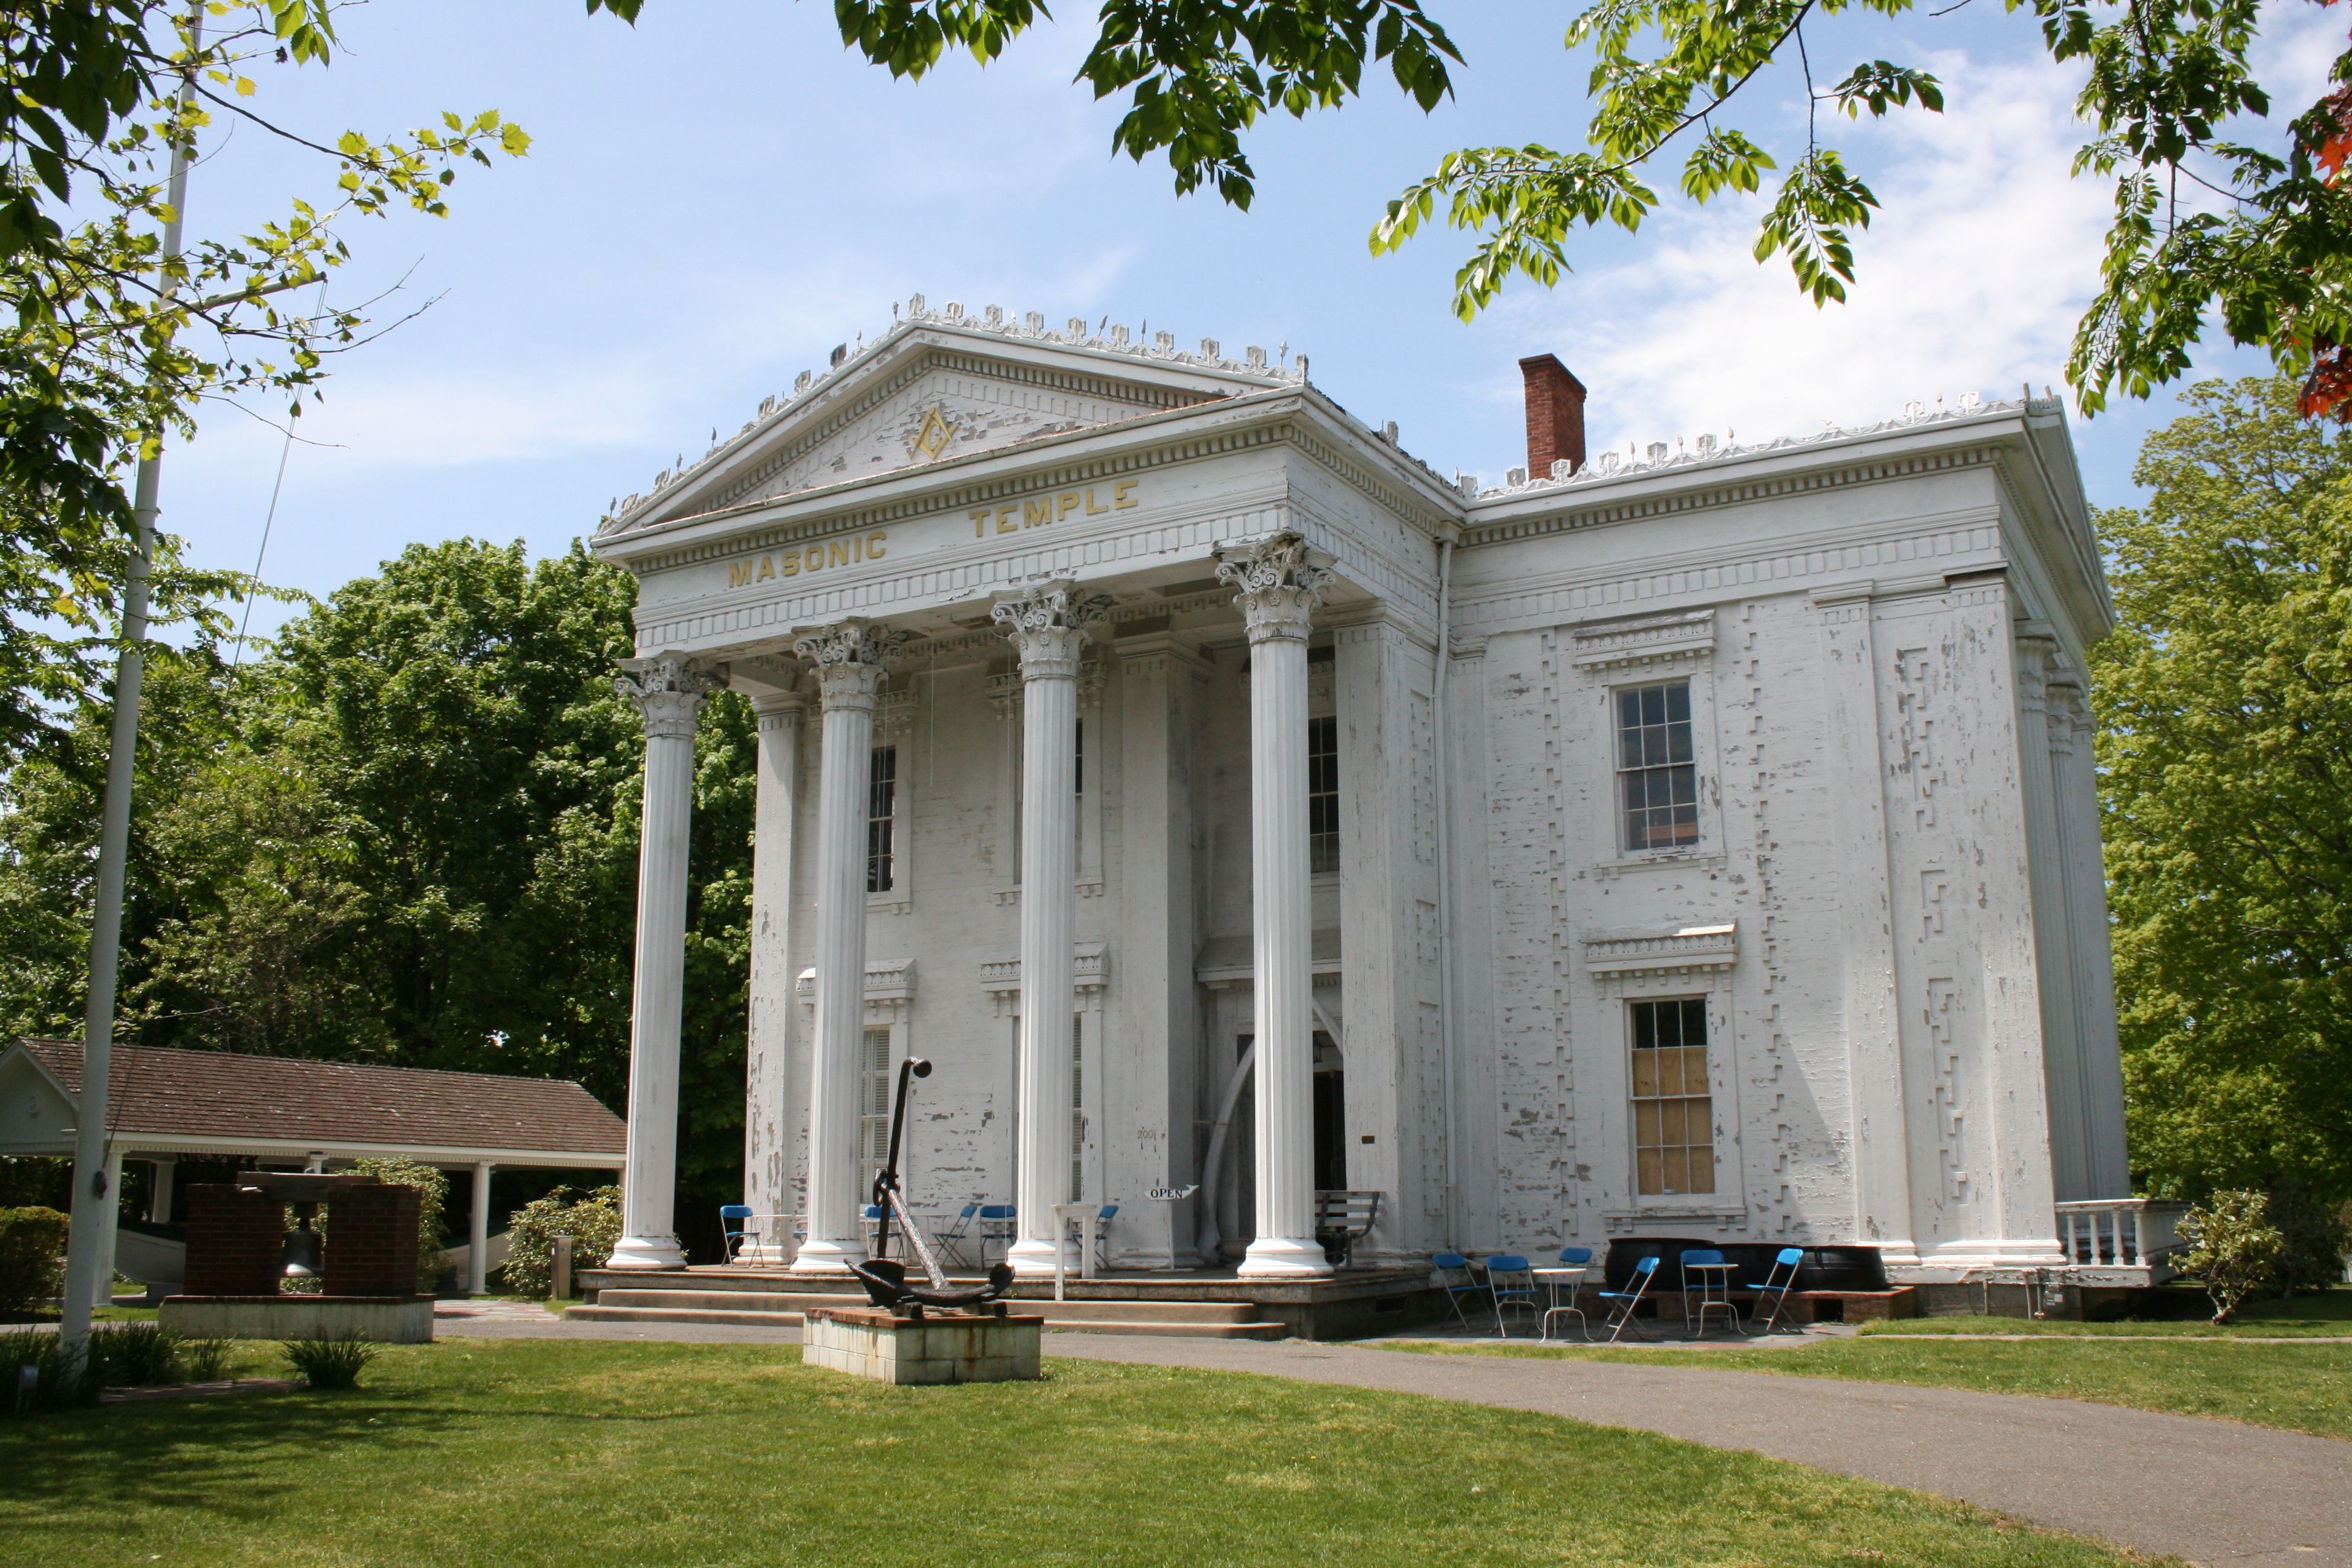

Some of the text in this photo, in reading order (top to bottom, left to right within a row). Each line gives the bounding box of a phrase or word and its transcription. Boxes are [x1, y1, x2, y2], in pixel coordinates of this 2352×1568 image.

[728, 480, 1139, 588] MASONIC TEMPLE
[1137, 1129, 1154, 1139] 200
[1150, 1188, 1183, 1199] OPEN
